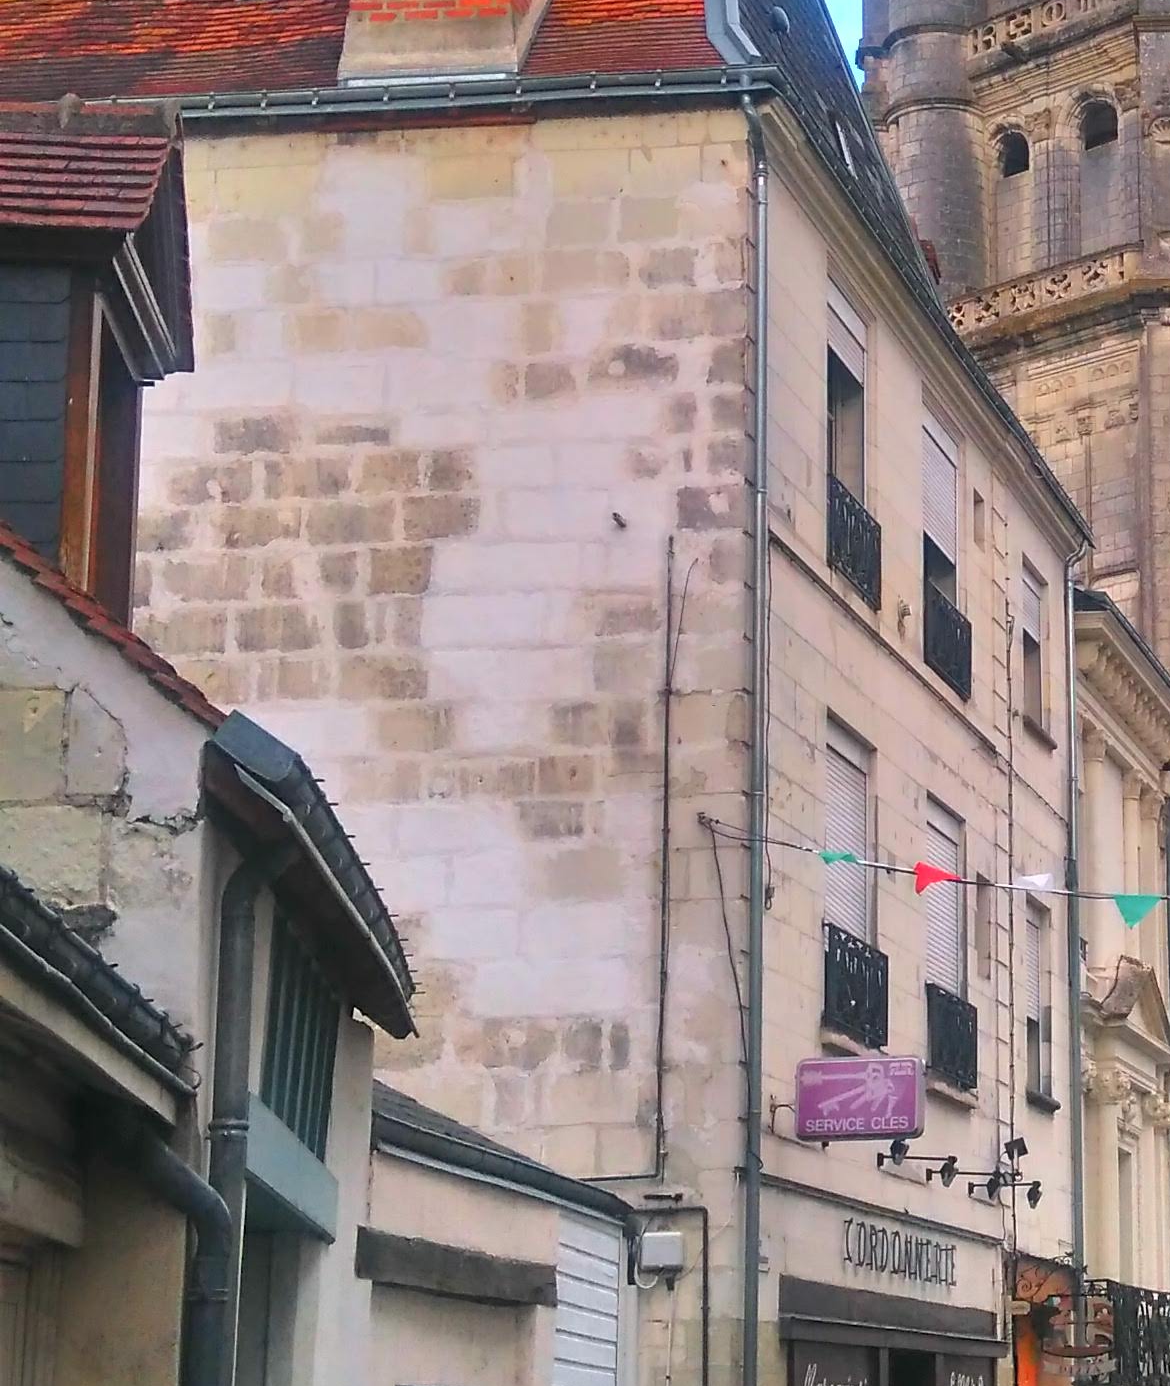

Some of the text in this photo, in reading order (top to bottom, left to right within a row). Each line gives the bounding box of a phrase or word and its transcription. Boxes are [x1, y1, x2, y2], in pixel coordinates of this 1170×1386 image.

[805, 1116, 909, 1132] SERVICE CLES
[844, 1217, 957, 1286] CORDONNERIE
